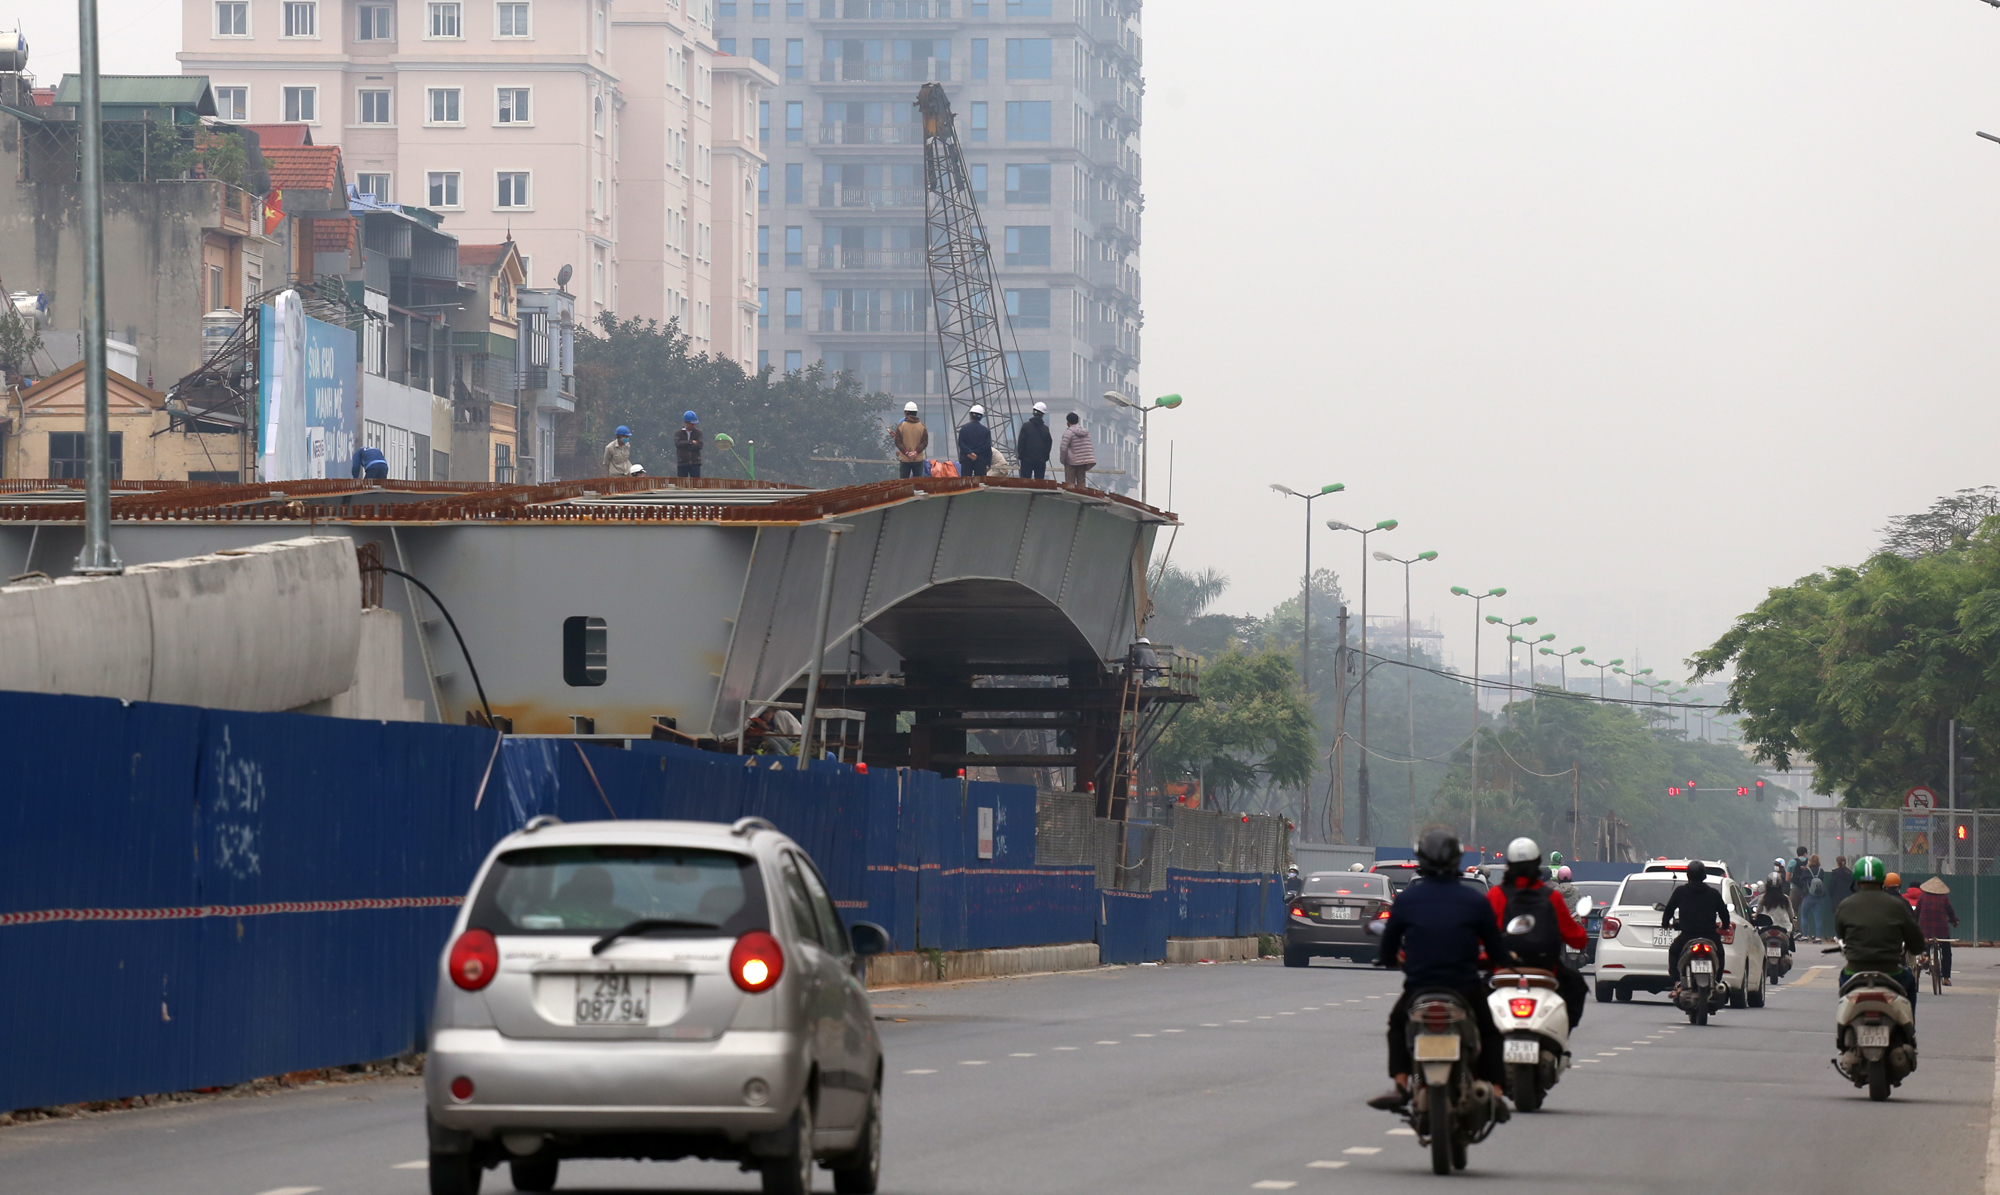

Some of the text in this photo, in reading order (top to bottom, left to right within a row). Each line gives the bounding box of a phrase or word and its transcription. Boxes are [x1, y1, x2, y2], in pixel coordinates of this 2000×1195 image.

[316, 387, 333, 424] MẠNH
[1668, 786, 1680, 796] 01
[1736, 786, 1748, 796] 21
[1653, 937, 1674, 945] 701.3
[594, 973, 632, 997] 29A
